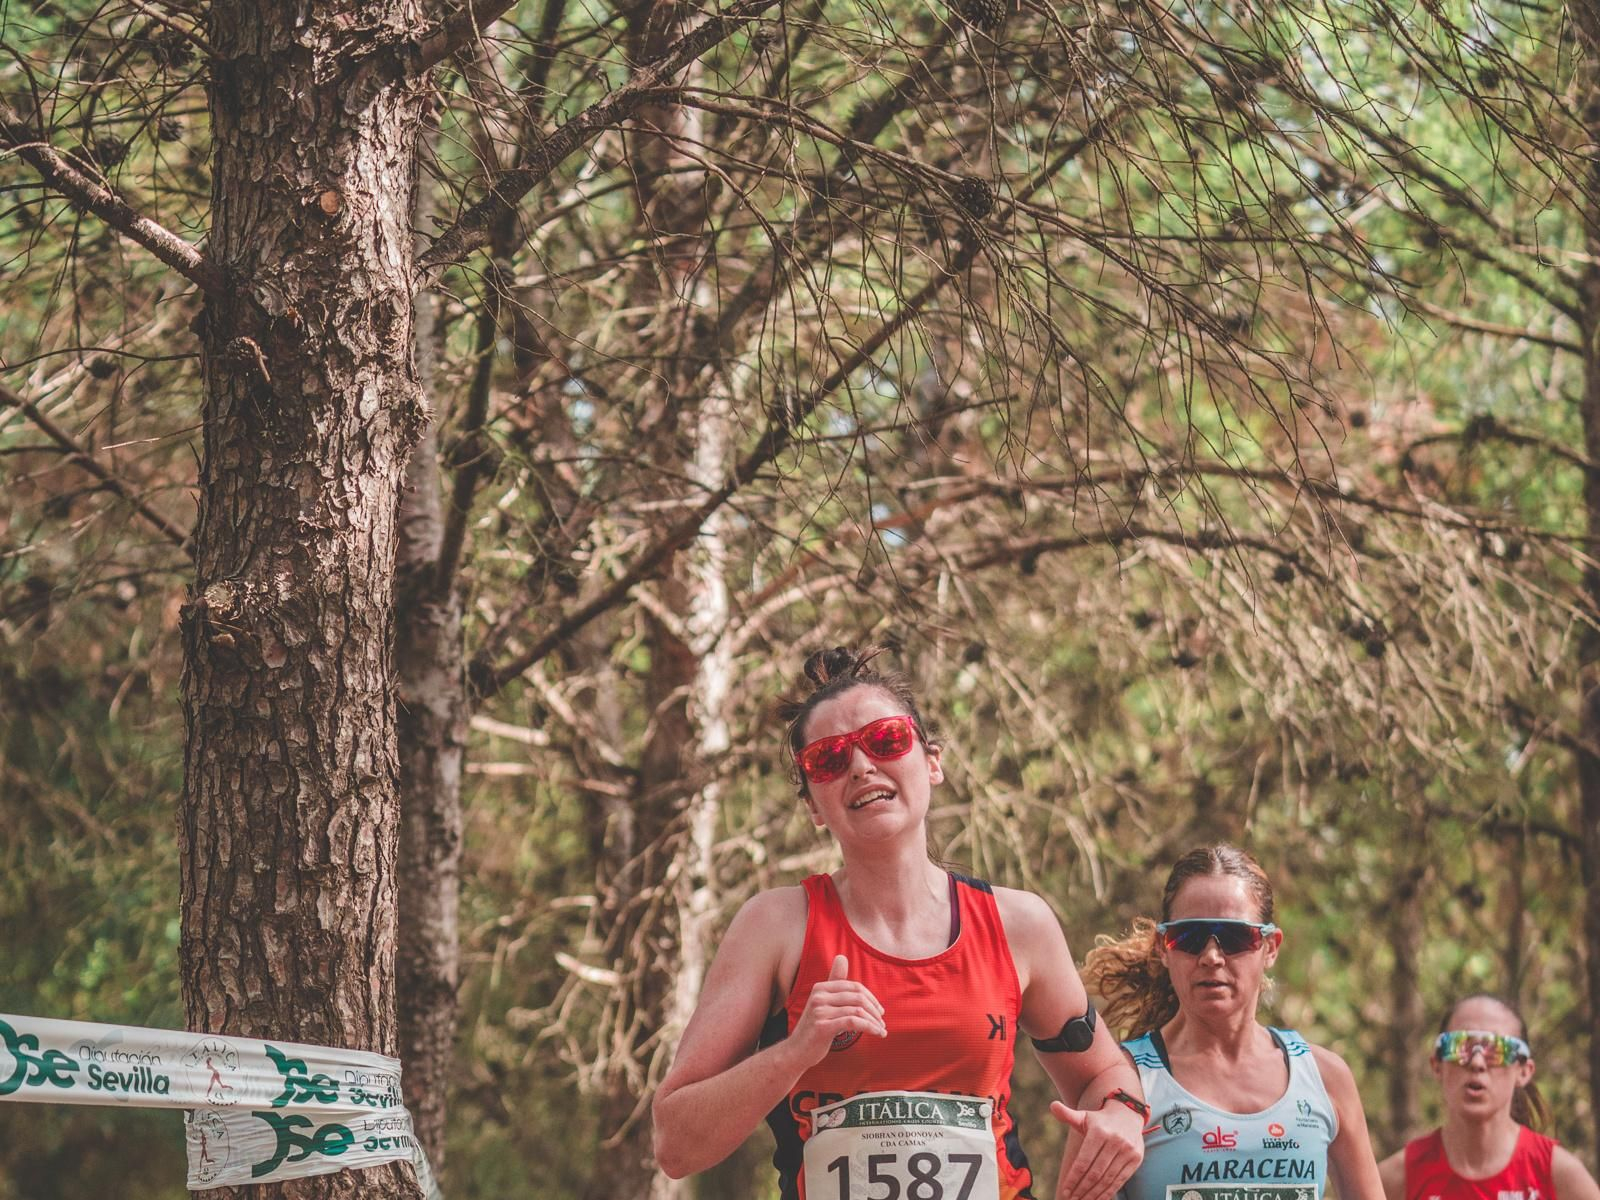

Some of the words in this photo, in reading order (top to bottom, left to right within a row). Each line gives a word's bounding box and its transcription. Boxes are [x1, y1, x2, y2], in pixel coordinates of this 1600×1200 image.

[88, 1064, 170, 1095] Sevilla
[859, 1098, 945, 1120] ITÁLICA
[1181, 1158, 1316, 1185] MARACENA
